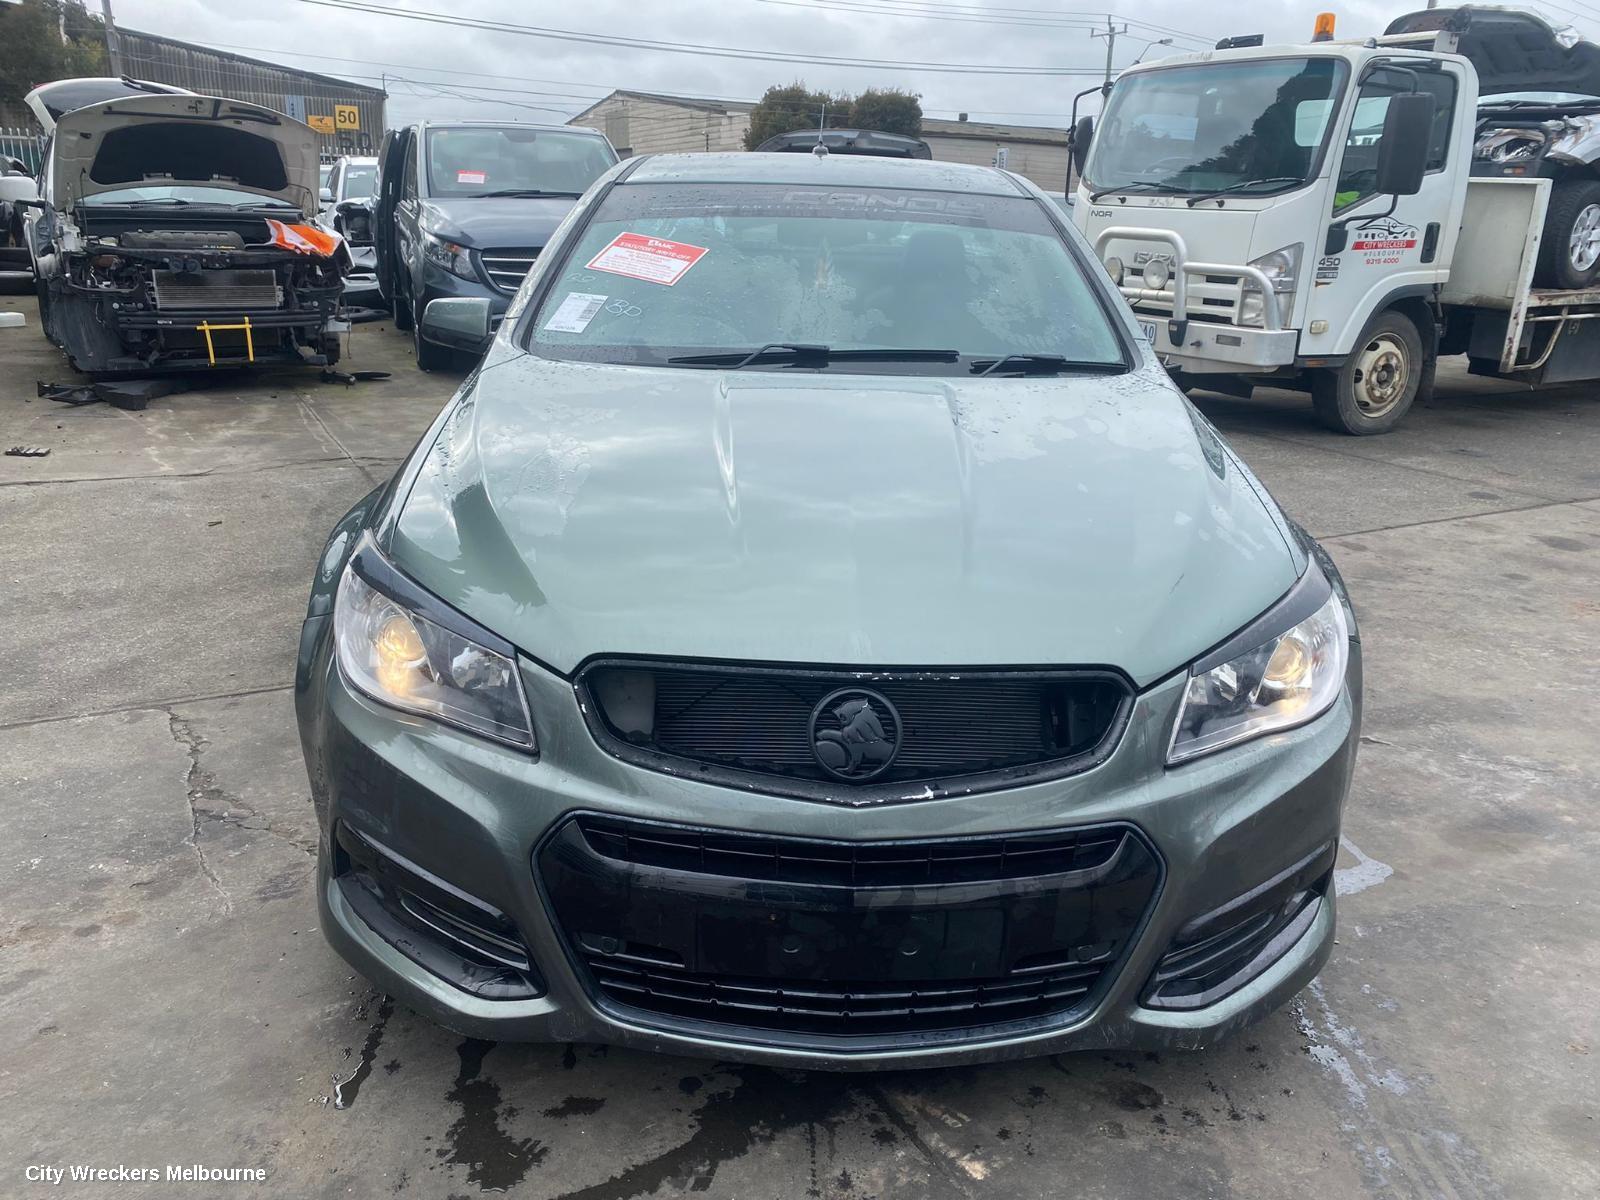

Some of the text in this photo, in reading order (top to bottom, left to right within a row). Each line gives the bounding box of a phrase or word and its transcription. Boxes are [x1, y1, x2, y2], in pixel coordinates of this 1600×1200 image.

[338, 110, 357, 124] 50
[1363, 240, 1407, 249] CITY WRECKERS
[1318, 257, 1341, 266] 450
